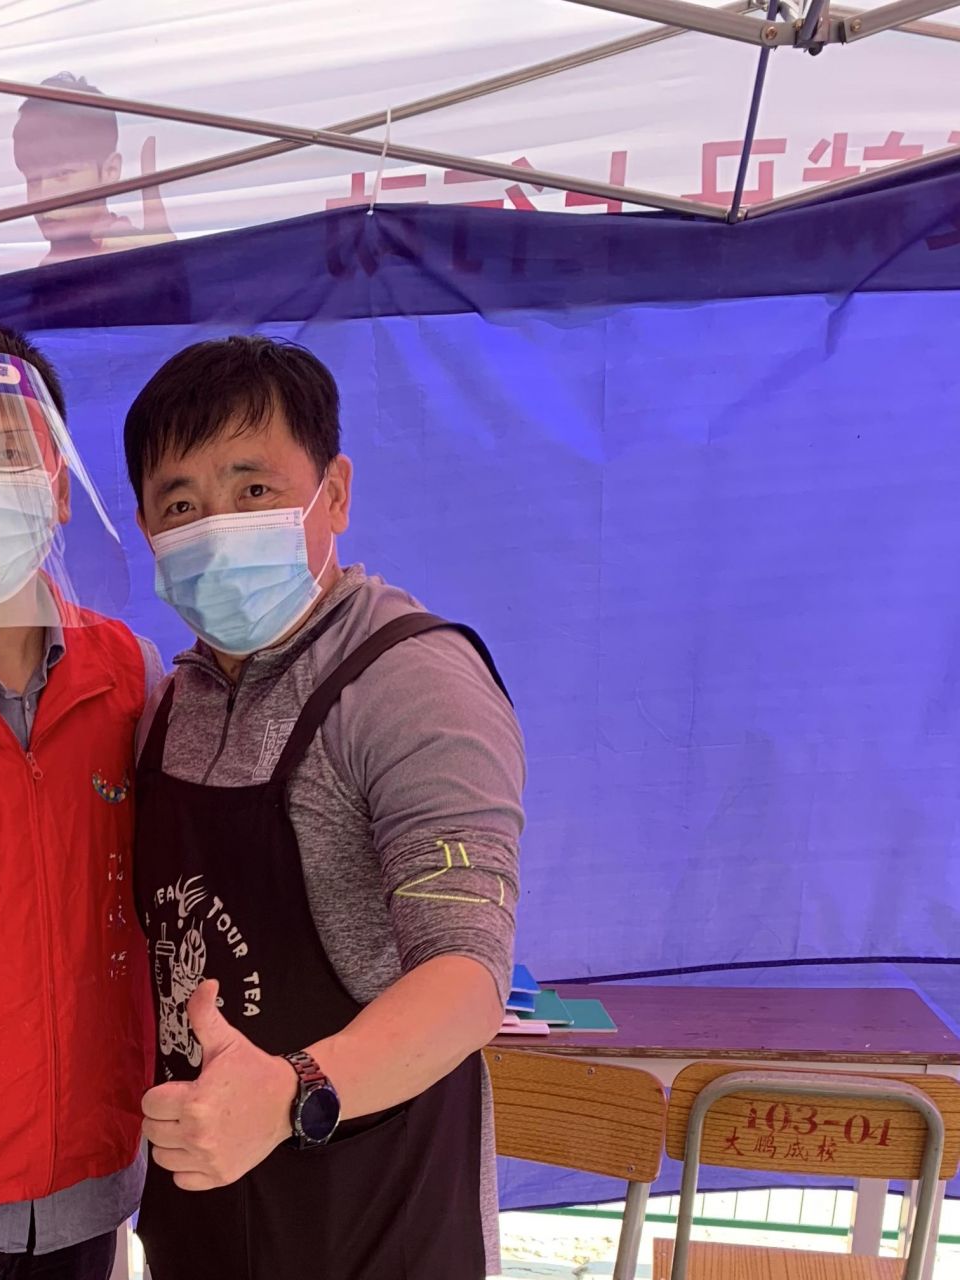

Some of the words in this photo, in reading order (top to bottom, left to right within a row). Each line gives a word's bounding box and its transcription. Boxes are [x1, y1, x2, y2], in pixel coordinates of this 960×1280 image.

[206, 896, 249, 959] TOUR
[243, 971, 261, 1017] TEA
[743, 1102, 892, 1147] 103-04
